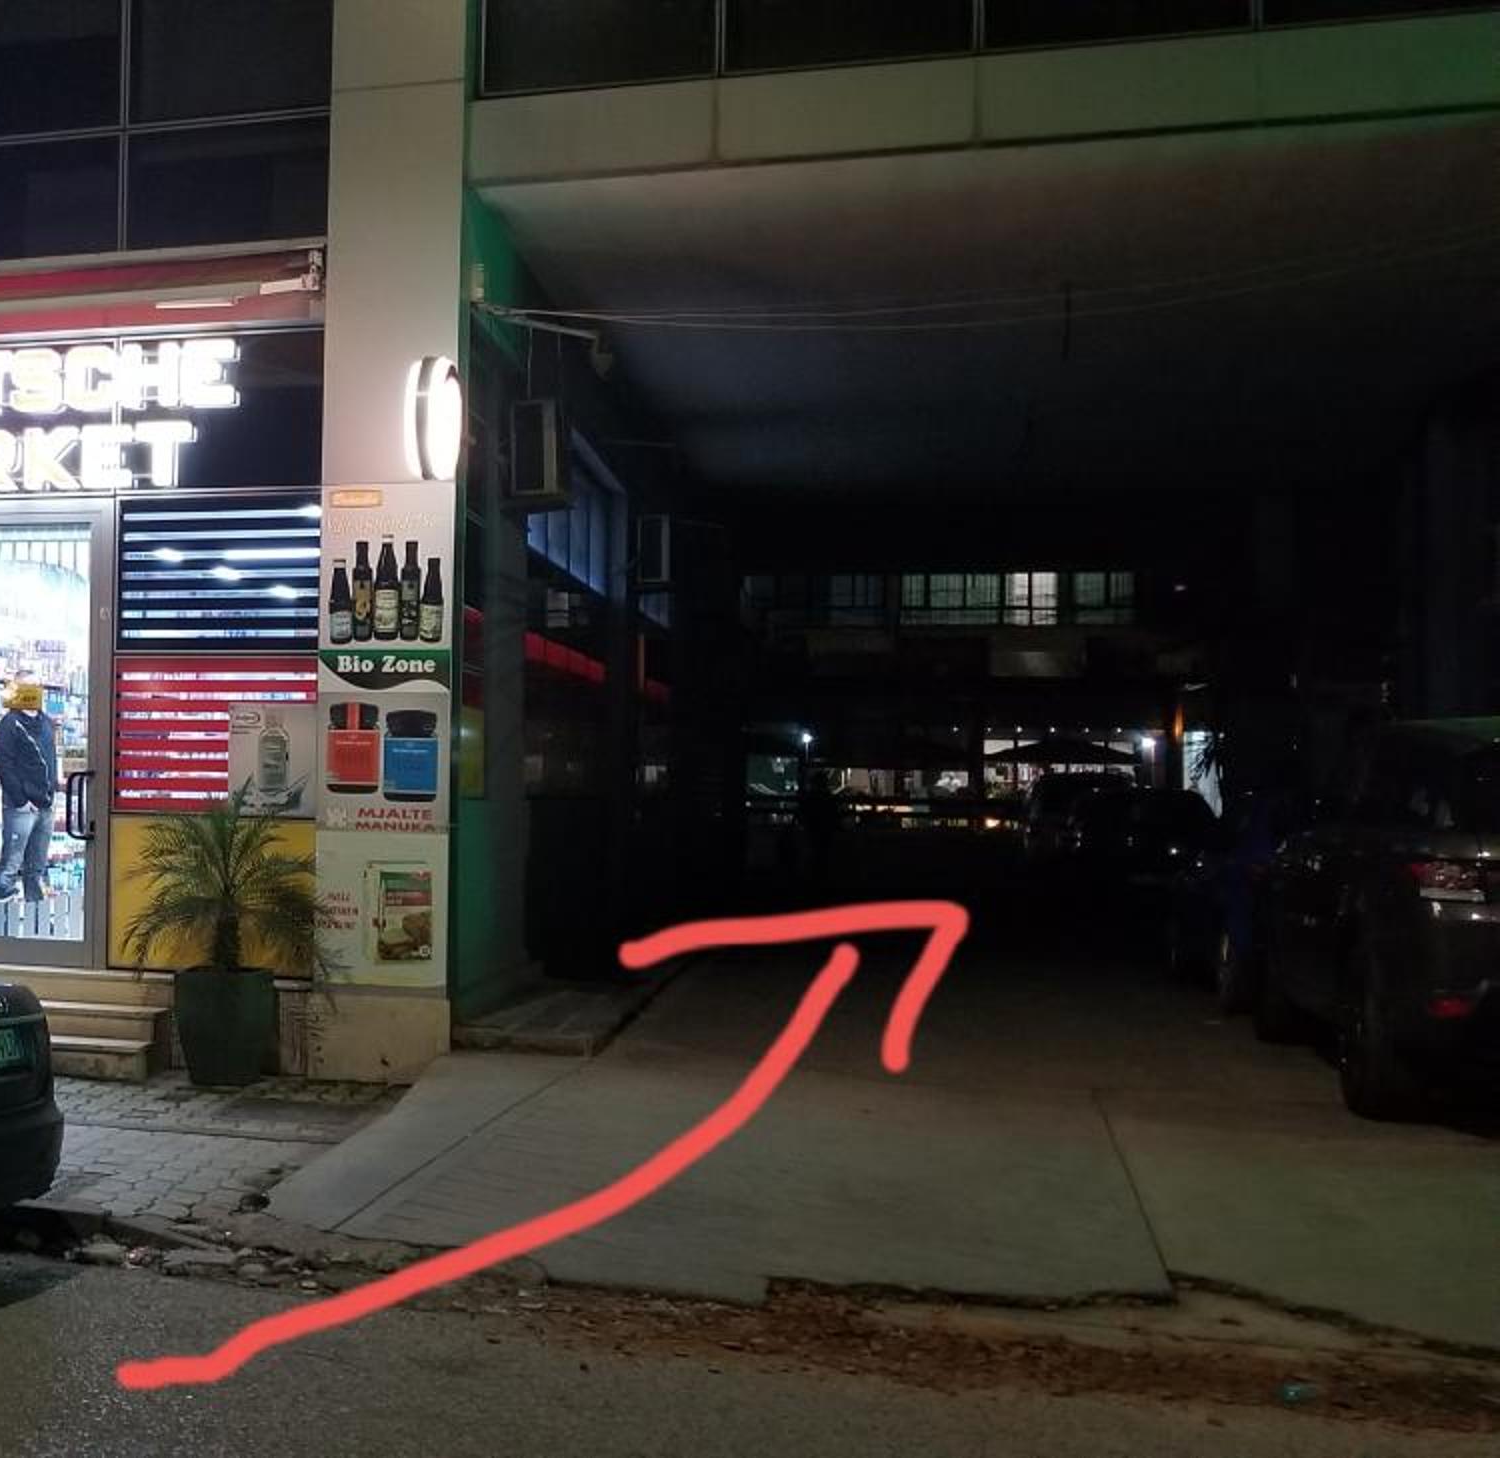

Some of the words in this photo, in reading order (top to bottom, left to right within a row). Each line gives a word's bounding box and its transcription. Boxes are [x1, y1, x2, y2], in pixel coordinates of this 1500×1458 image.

[337, 655, 374, 673] Bio
[381, 655, 436, 673] Zone
[355, 822, 436, 832] MANUKA
